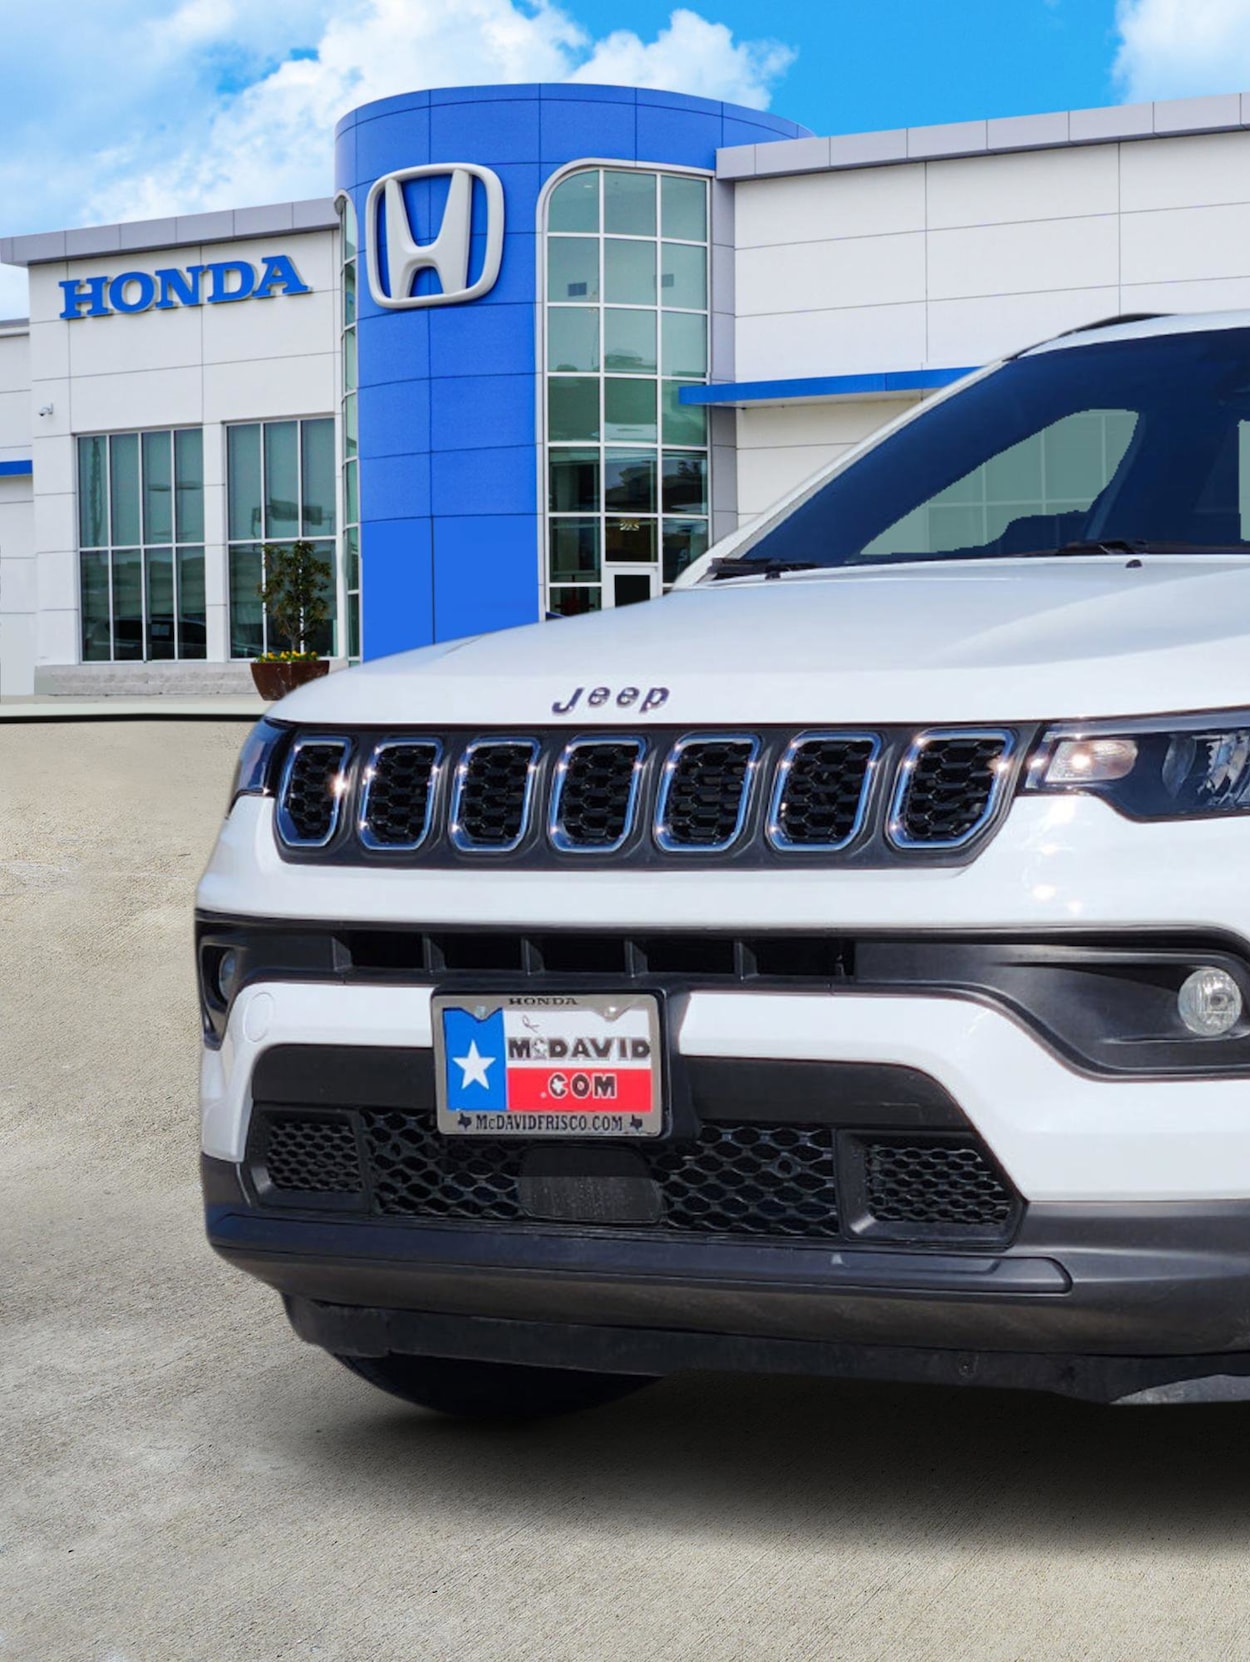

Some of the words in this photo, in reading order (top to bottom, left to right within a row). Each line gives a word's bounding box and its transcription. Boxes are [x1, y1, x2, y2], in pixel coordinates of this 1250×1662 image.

[58, 254, 312, 320] HONDA
[551, 686, 670, 715] Jeep
[508, 997, 579, 1006] HONDA
[540, 1071, 618, 1099] .COM
[475, 1114, 623, 1131] McDAVIDFRISCO.COM
